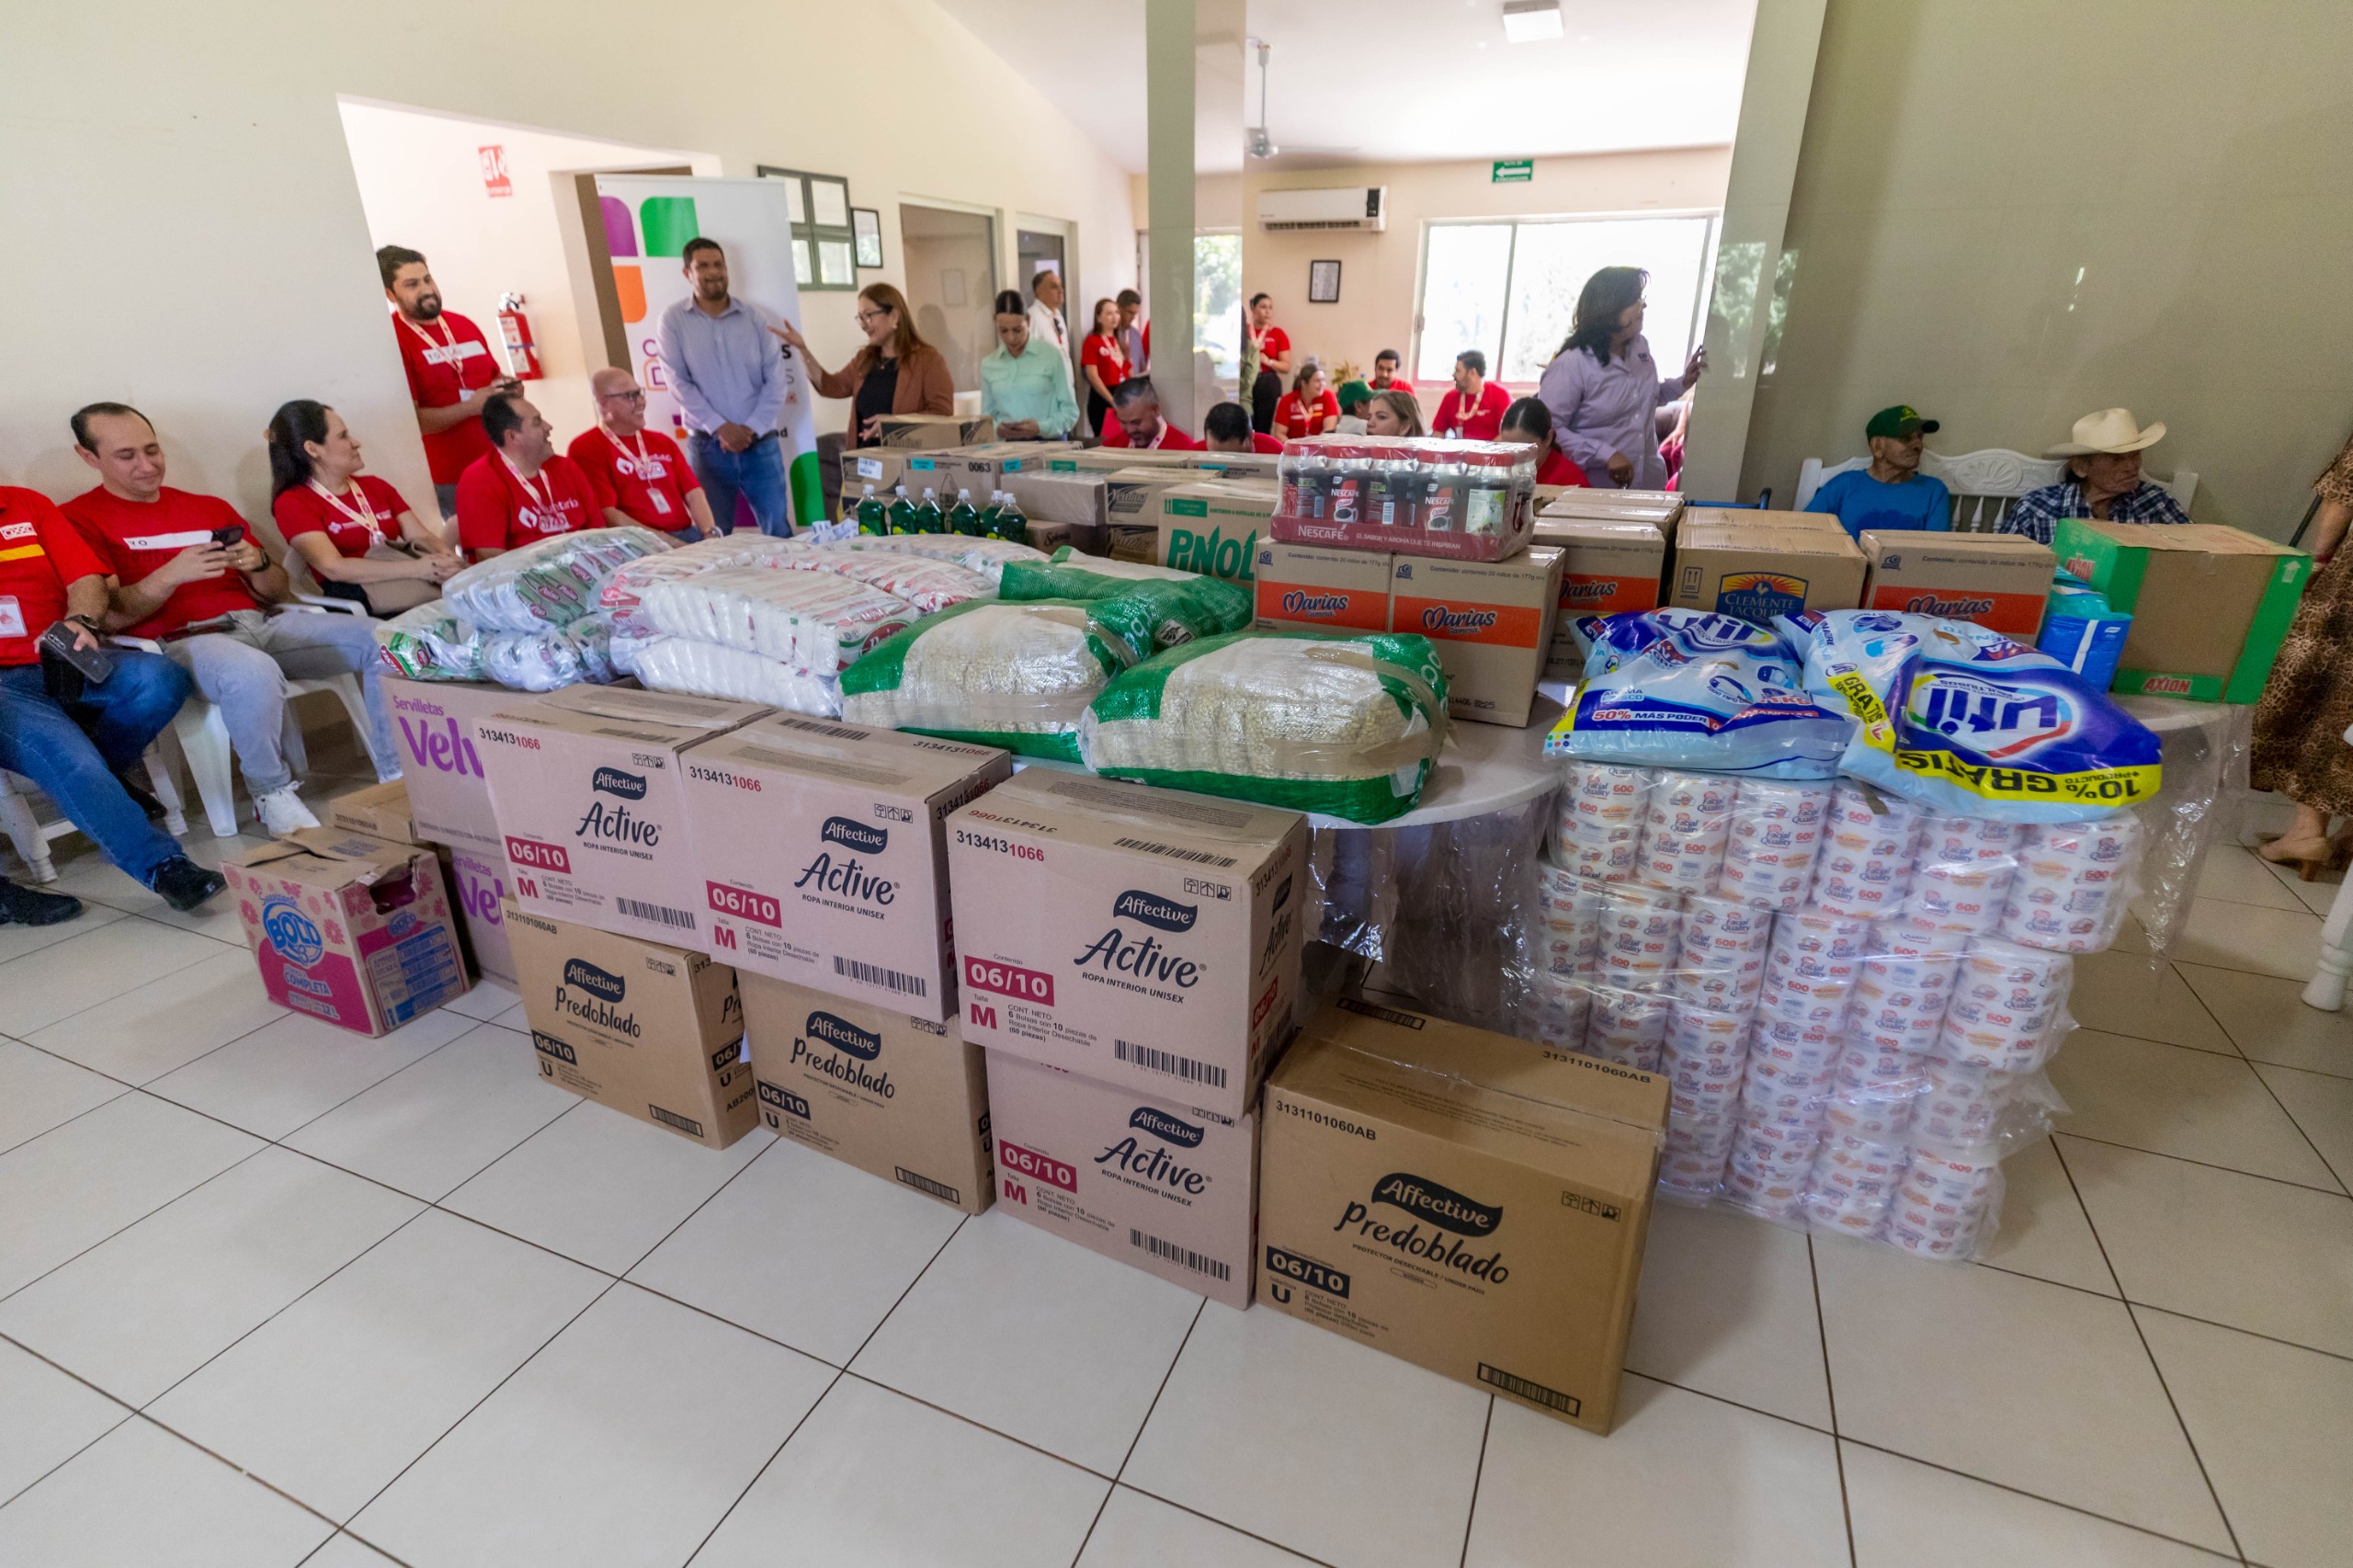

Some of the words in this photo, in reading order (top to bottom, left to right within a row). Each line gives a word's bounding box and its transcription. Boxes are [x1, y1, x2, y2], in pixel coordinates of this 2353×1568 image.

[968, 462, 991, 472] 0063
[1432, 540, 1461, 550] INSPIRAN
[1430, 565, 1461, 574] Contenido:
[1283, 590, 1349, 614] Marias
[1725, 593, 1795, 608] CLEMENTE
[1423, 606, 1496, 631] Marias
[2143, 676, 2193, 696] AXION
[392, 695, 445, 717] Servilletas
[1593, 710, 1631, 721] 50%
[1667, 712, 1707, 723] PODER
[479, 727, 540, 750] 3134131066
[913, 741, 992, 756] 3134131066
[596, 772, 643, 792] Affective
[689, 766, 762, 792] 3134131066
[1898, 751, 2057, 793] GRATIS
[1613, 785, 1633, 793] 600
[2066, 778, 2141, 800] 10%
[575, 801, 659, 846] Active
[824, 821, 883, 846] Affective
[968, 809, 1058, 834] 3134131066
[511, 842, 565, 868] 06/10
[583, 841, 599, 850] ROPA
[600, 845, 629, 856] INTERIOR
[630, 850, 654, 861] UNISEX
[956, 830, 1045, 862] 3134131066
[1685, 844, 1706, 853] 600
[517, 877, 540, 899] M
[794, 853, 895, 905] Active
[712, 888, 776, 920] 06/10
[801, 894, 821, 905] ROPA
[822, 898, 855, 914] INTERIOR
[857, 906, 885, 921] UNISEX
[1120, 895, 1193, 925] Affective
[268, 912, 323, 954] BOLD
[506, 910, 558, 936] 3131101060AB
[714, 925, 737, 950] M
[1644, 943, 1665, 951] 600
[1715, 938, 1736, 948] 600
[994, 953, 1023, 966] Contenido
[1074, 928, 1199, 988] Active
[284, 971, 331, 996] COMPLETA
[567, 963, 622, 995] Affective
[971, 963, 1048, 998] 06/10
[1082, 971, 1105, 984] ROPA
[1106, 977, 1148, 994] INTERIOR
[1149, 987, 1185, 1005] UNISEX
[971, 1003, 997, 1030] M
[1016, 1013, 1038, 1024] Bolsas
[1052, 1022, 1063, 1031] 10
[1064, 1027, 1087, 1039] piezas
[1986, 1013, 2012, 1024] 600
[810, 1017, 876, 1052] Affective
[1008, 1019, 1027, 1029] Ropa
[1028, 1024, 1051, 1036] Interior
[1051, 1030, 1091, 1047] Desechable
[1021, 1030, 1047, 1042] piezas)
[535, 1035, 573, 1061] 06/10
[541, 1061, 553, 1077] U
[1542, 1051, 1651, 1083] 3131101060AB
[760, 1085, 806, 1115] 06/10
[766, 1111, 779, 1129] U
[1133, 1110, 1199, 1142] Affective
[1276, 1100, 1377, 1142] 3131101060AB
[1005, 1147, 1071, 1185] 06/10
[1094, 1137, 1205, 1195] Active
[1004, 1179, 1028, 1206] M
[1101, 1169, 1121, 1183] ROPA
[1123, 1176, 1160, 1197] INTERIOR
[1161, 1190, 1192, 1207] UNISEX
[1381, 1179, 1491, 1230] Affective
[1272, 1253, 1344, 1291] 06/10
[1353, 1244, 1392, 1263] PROTECTOR
[1393, 1257, 1438, 1279] DESECHABLE
[1444, 1277, 1467, 1290] UNDER
[1271, 1283, 1290, 1304] U
